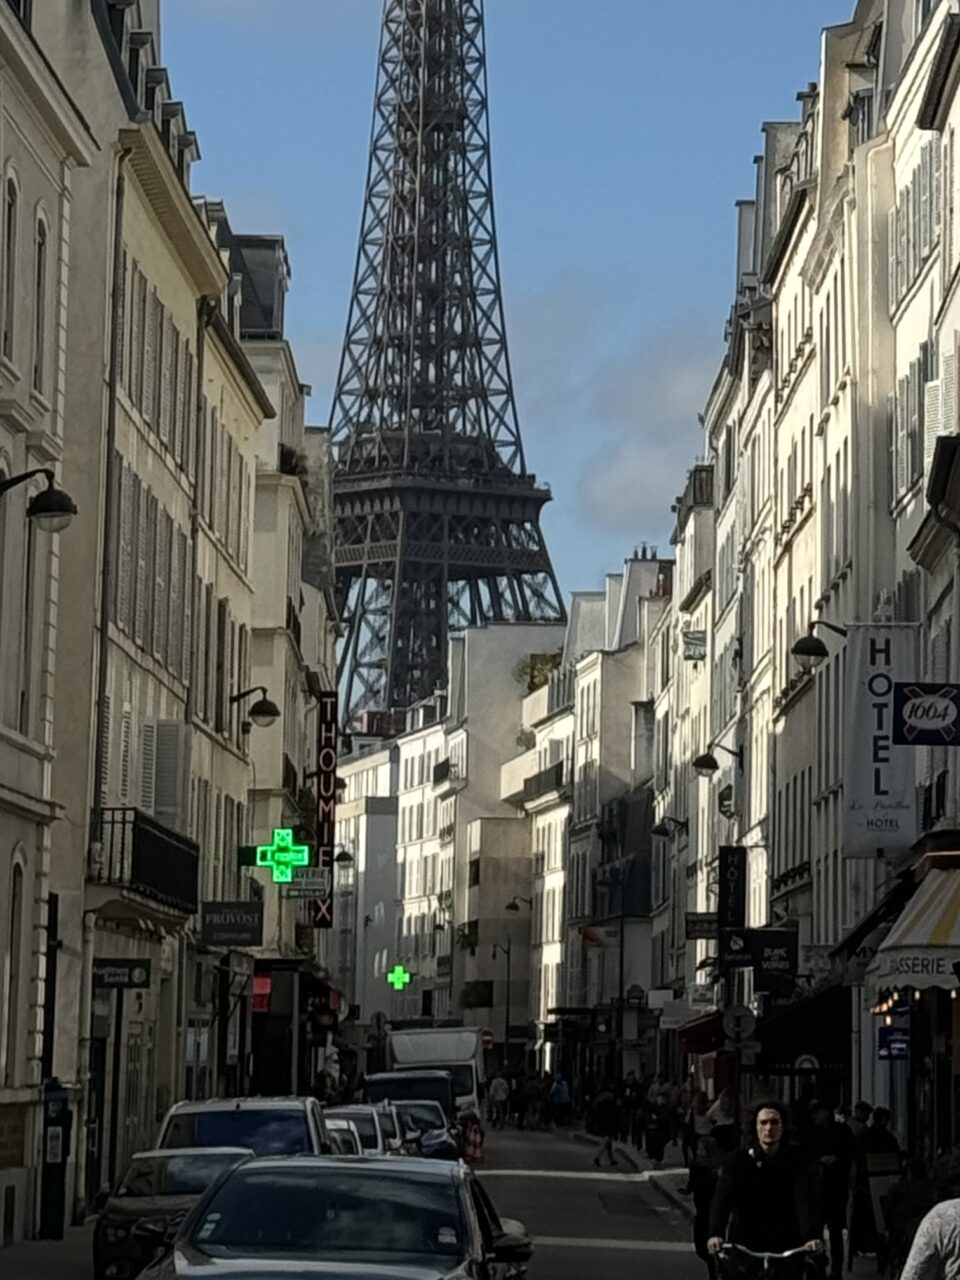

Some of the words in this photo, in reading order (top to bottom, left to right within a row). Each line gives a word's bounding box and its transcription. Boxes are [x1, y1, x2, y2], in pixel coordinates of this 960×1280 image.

[868, 638, 892, 796] HOTEL
[906, 700, 951, 722] 1664
[316, 696, 337, 921] THOUMIEX
[293, 869, 325, 879] AVERIE
[206, 912, 259, 925] PROVOST
